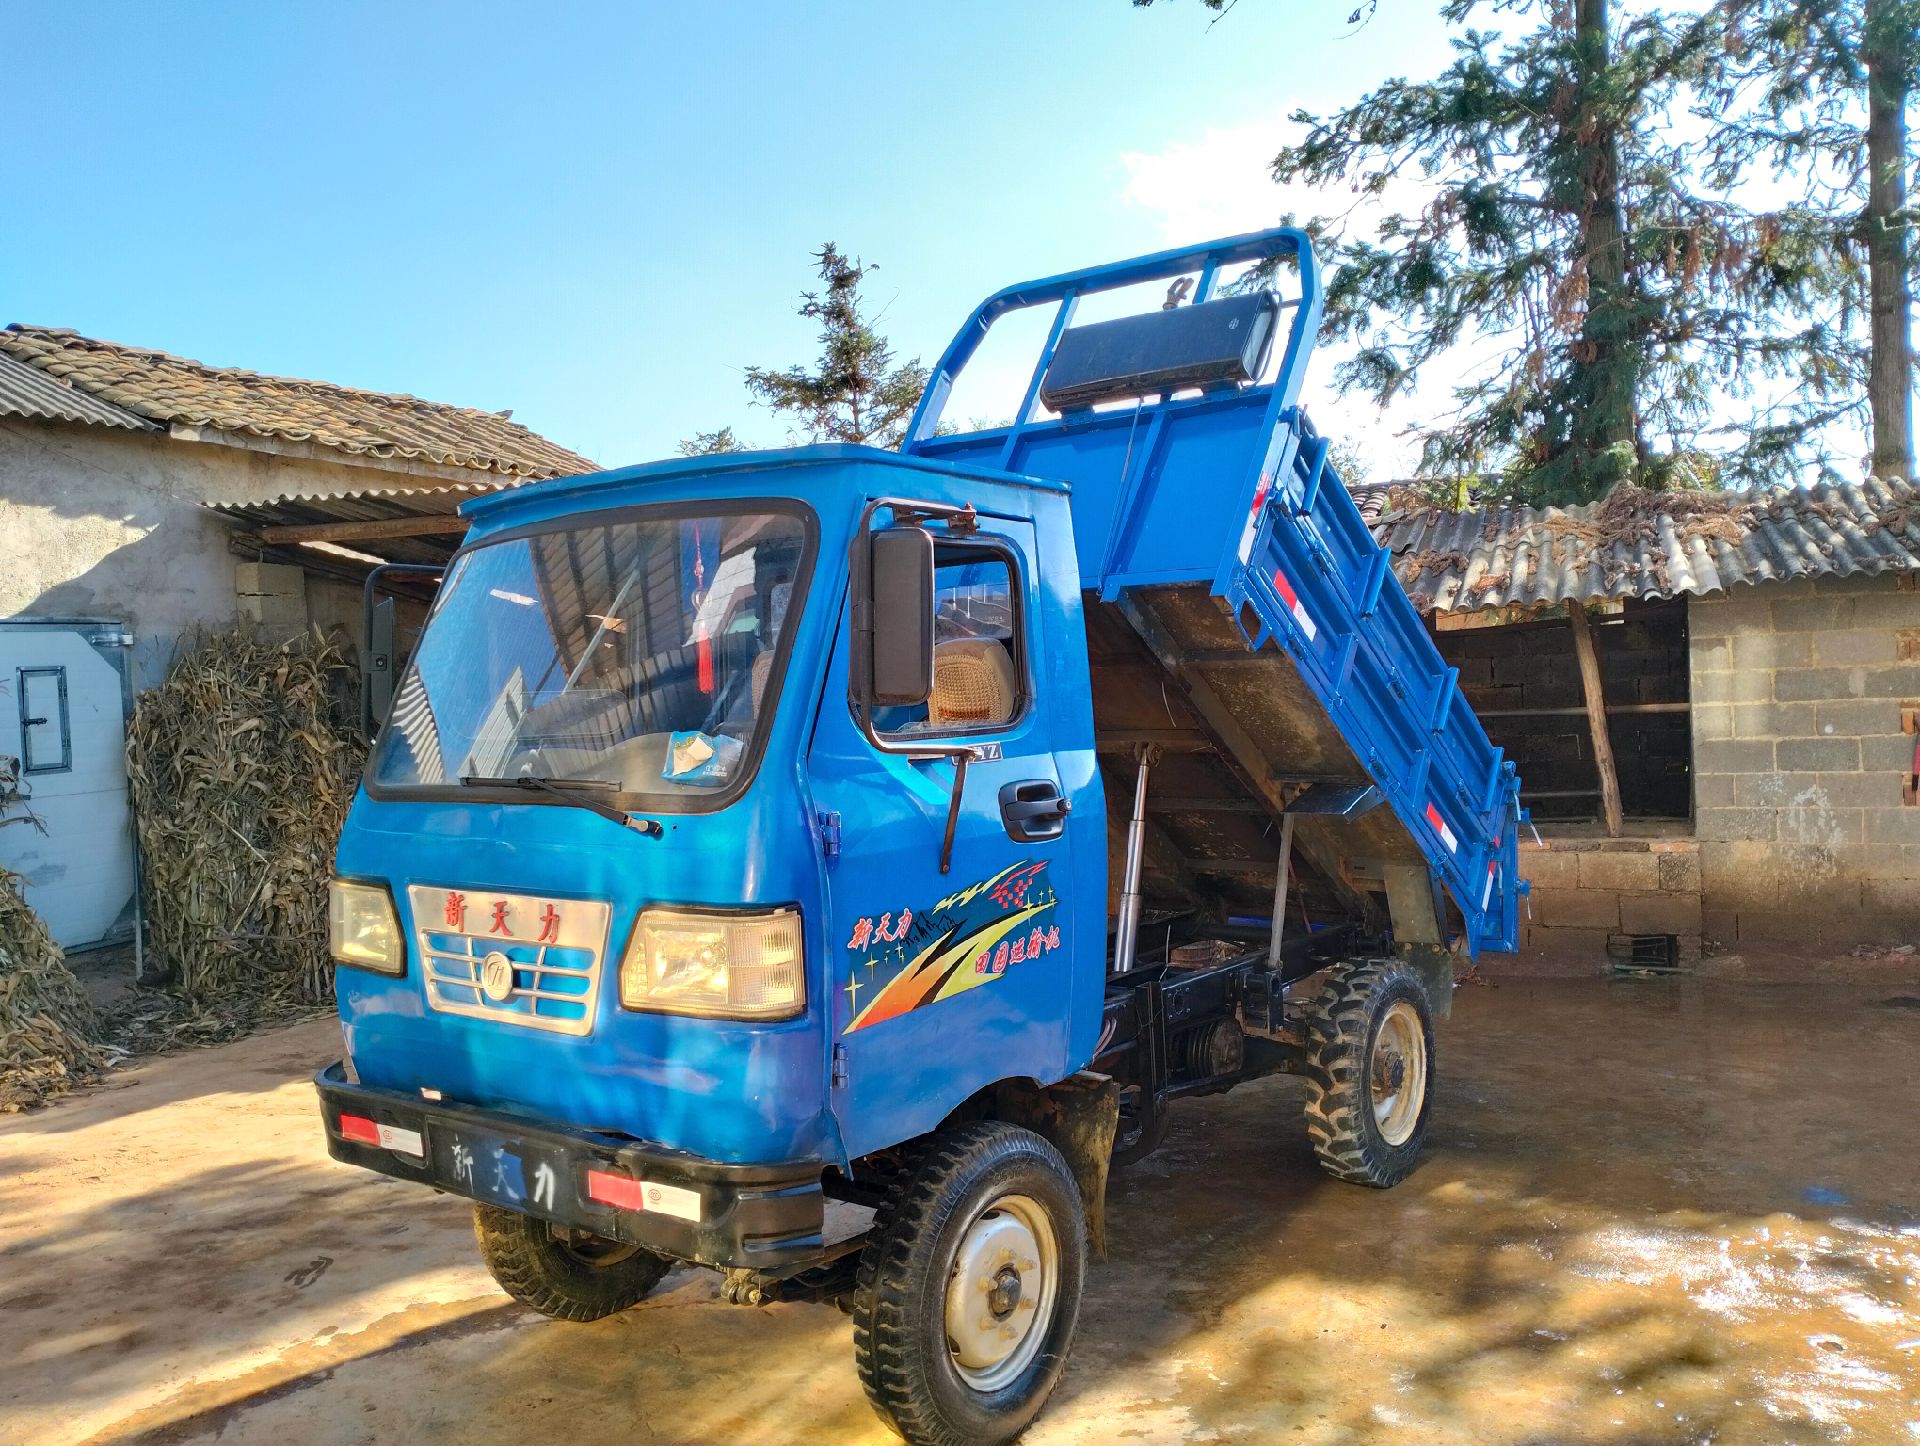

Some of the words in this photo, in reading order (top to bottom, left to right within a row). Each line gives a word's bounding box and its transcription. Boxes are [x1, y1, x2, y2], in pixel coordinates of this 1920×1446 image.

[443, 891, 560, 944] 新天力
[847, 907, 913, 952] 新天力
